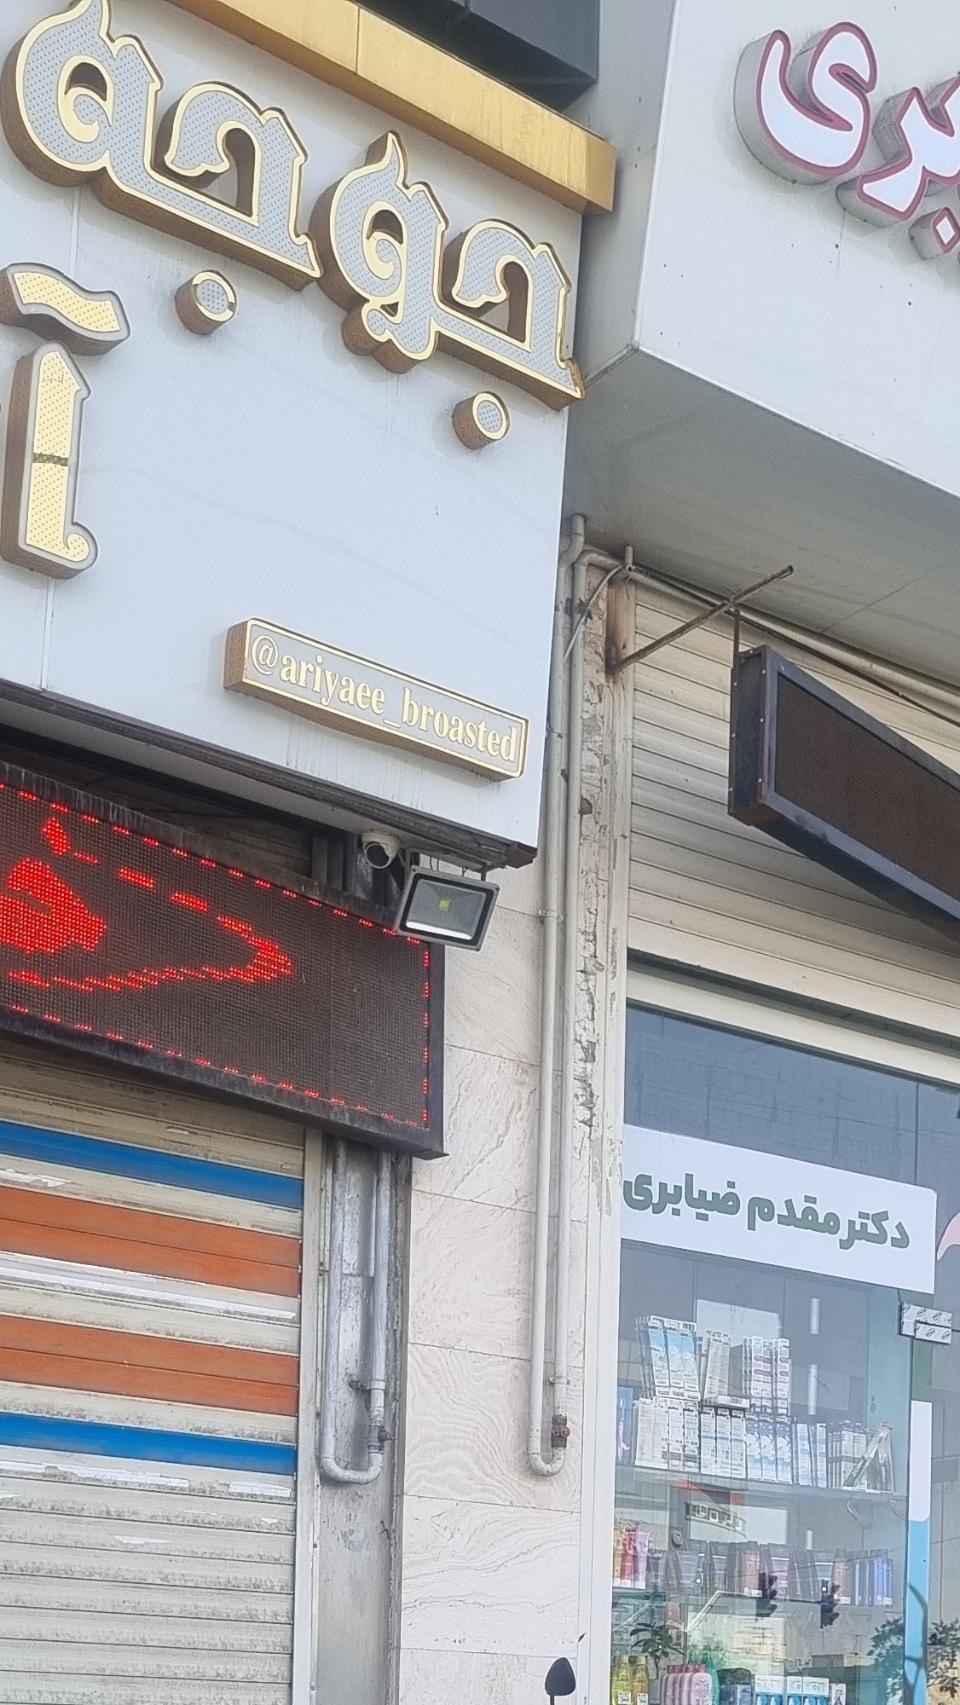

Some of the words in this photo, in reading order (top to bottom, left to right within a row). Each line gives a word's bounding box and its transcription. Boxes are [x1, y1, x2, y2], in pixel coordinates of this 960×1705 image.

[251, 635, 518, 763] @ariyaee_broasted
[623, 1173, 741, 1222] ضیابری
[747, 1194, 840, 1235] مقدم
[839, 1210, 910, 1250] دکتر
